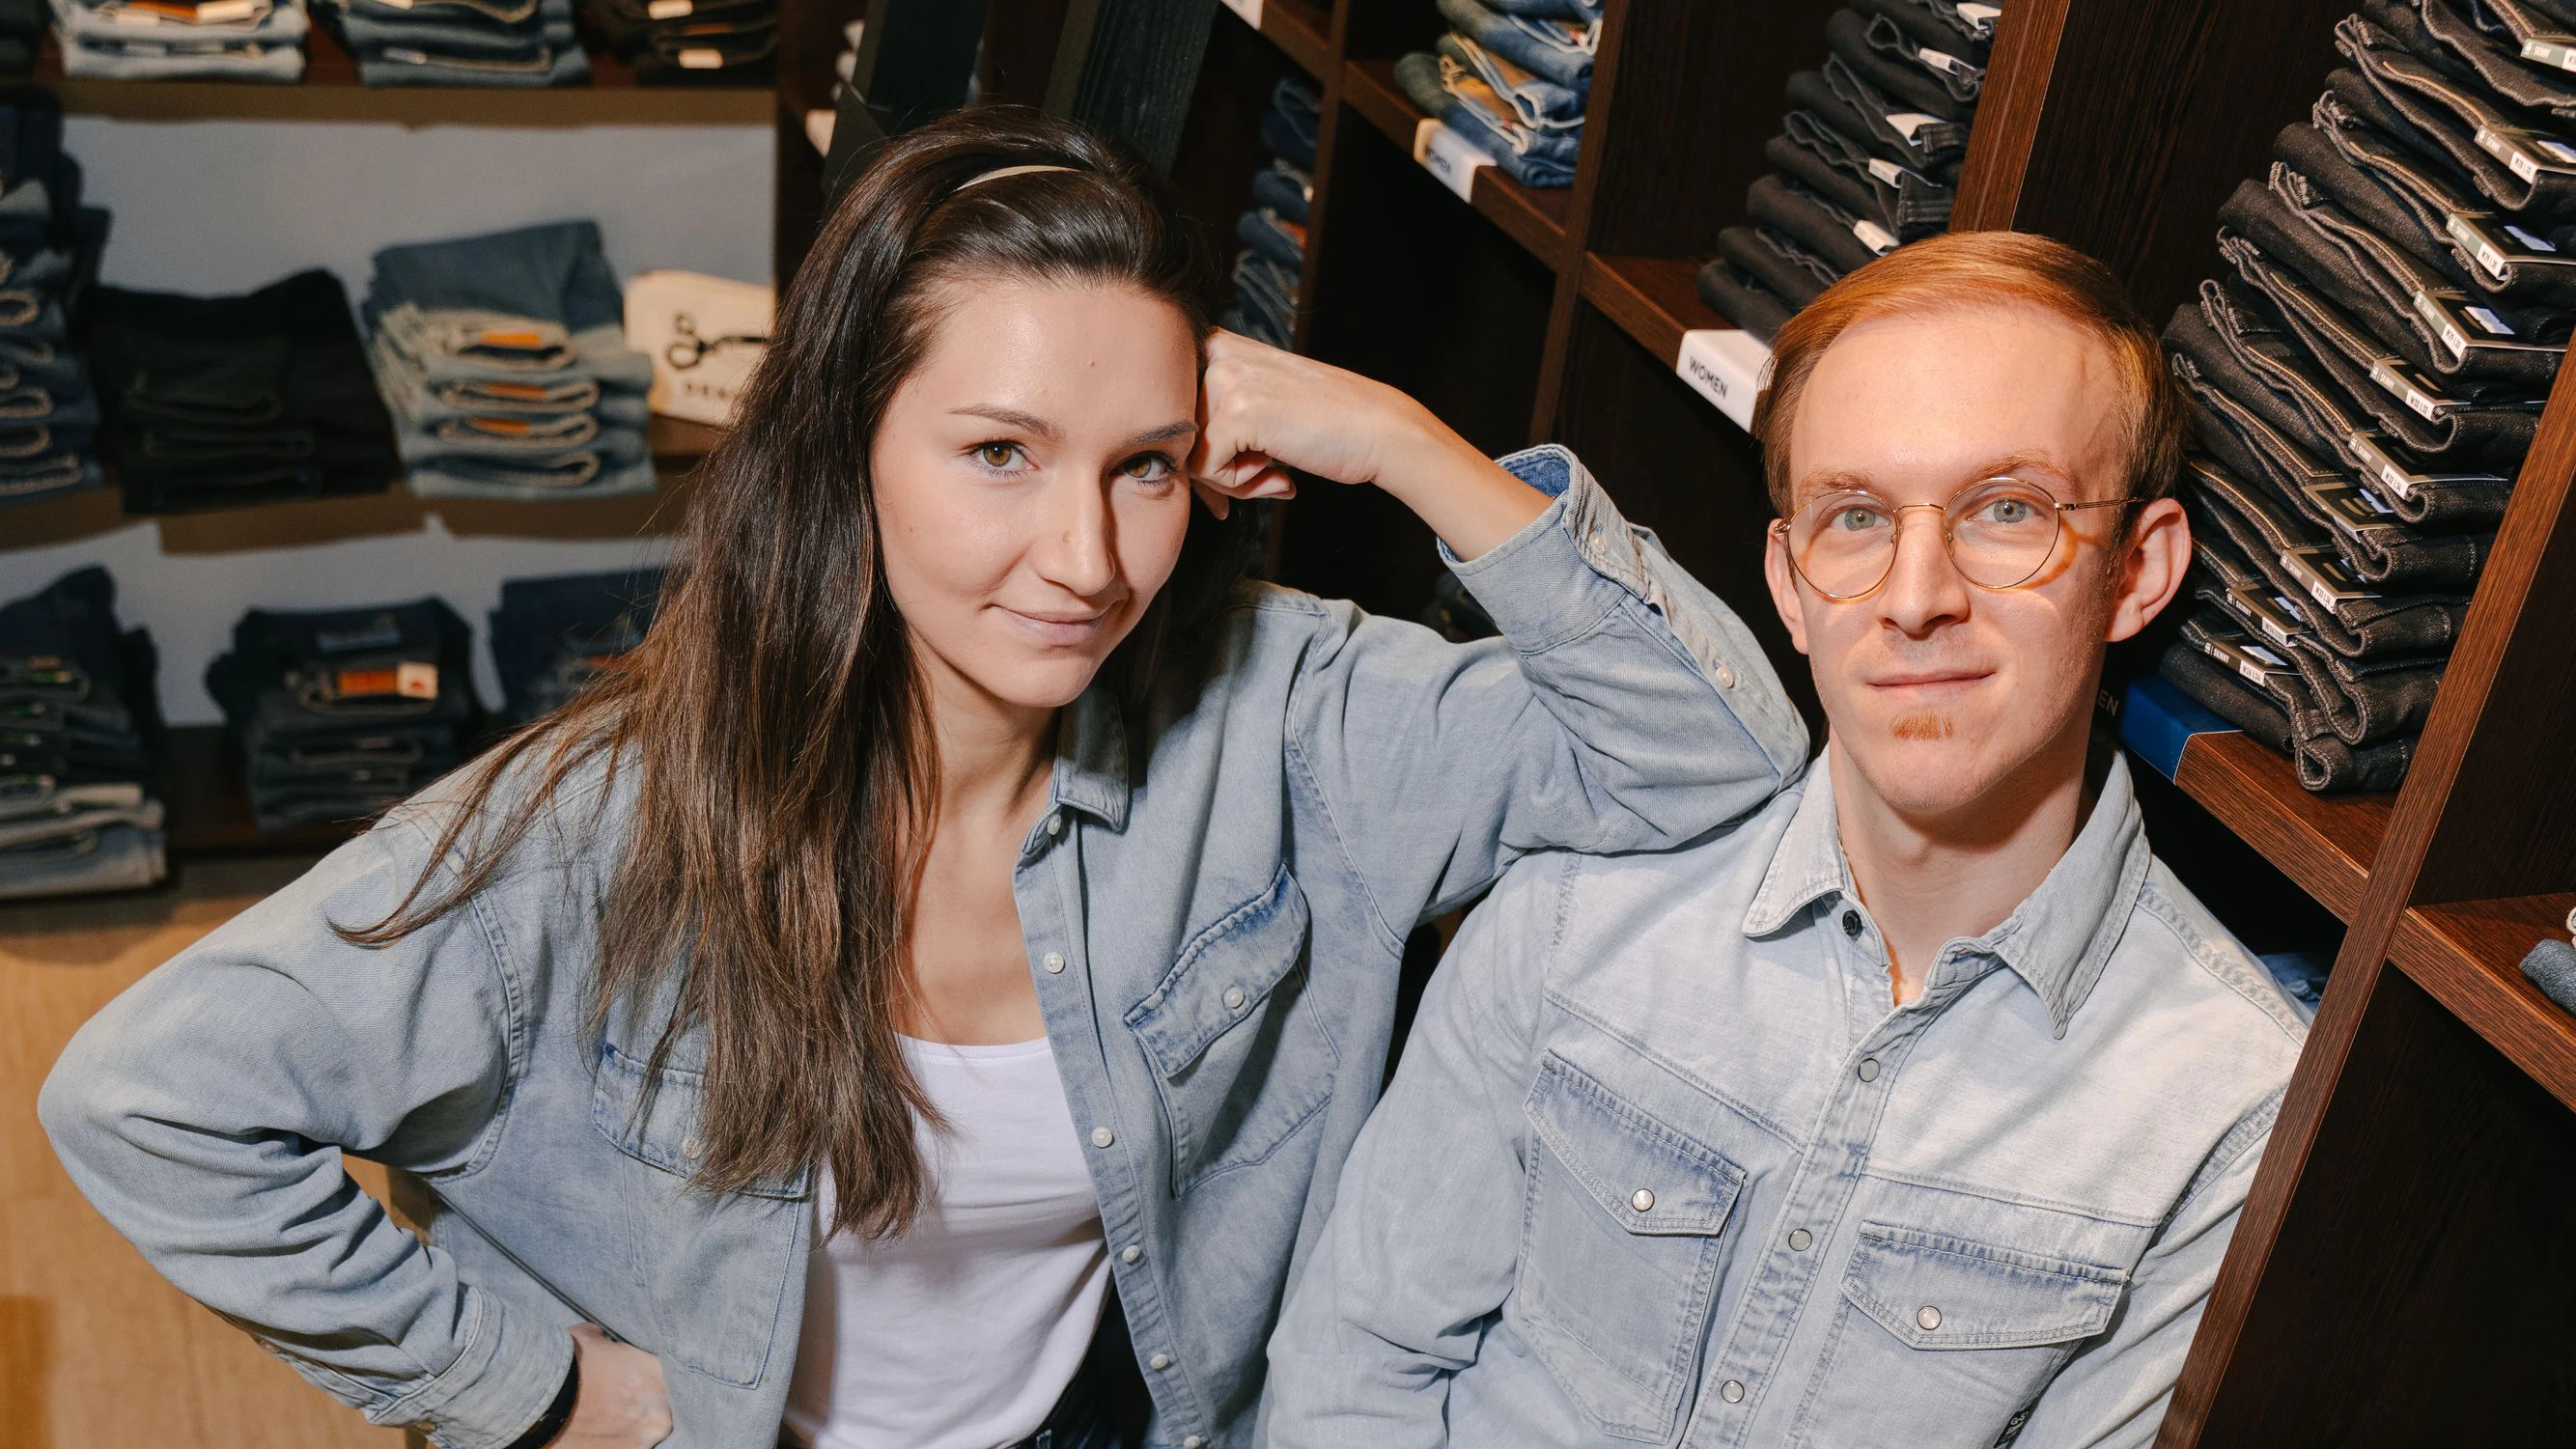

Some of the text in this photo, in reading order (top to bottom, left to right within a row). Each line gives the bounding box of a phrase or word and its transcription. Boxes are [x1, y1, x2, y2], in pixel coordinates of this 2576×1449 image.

[1424, 144, 1452, 175] WOMEN
[1689, 354, 1728, 399] WOMEN
[2097, 688, 2119, 717] EN
